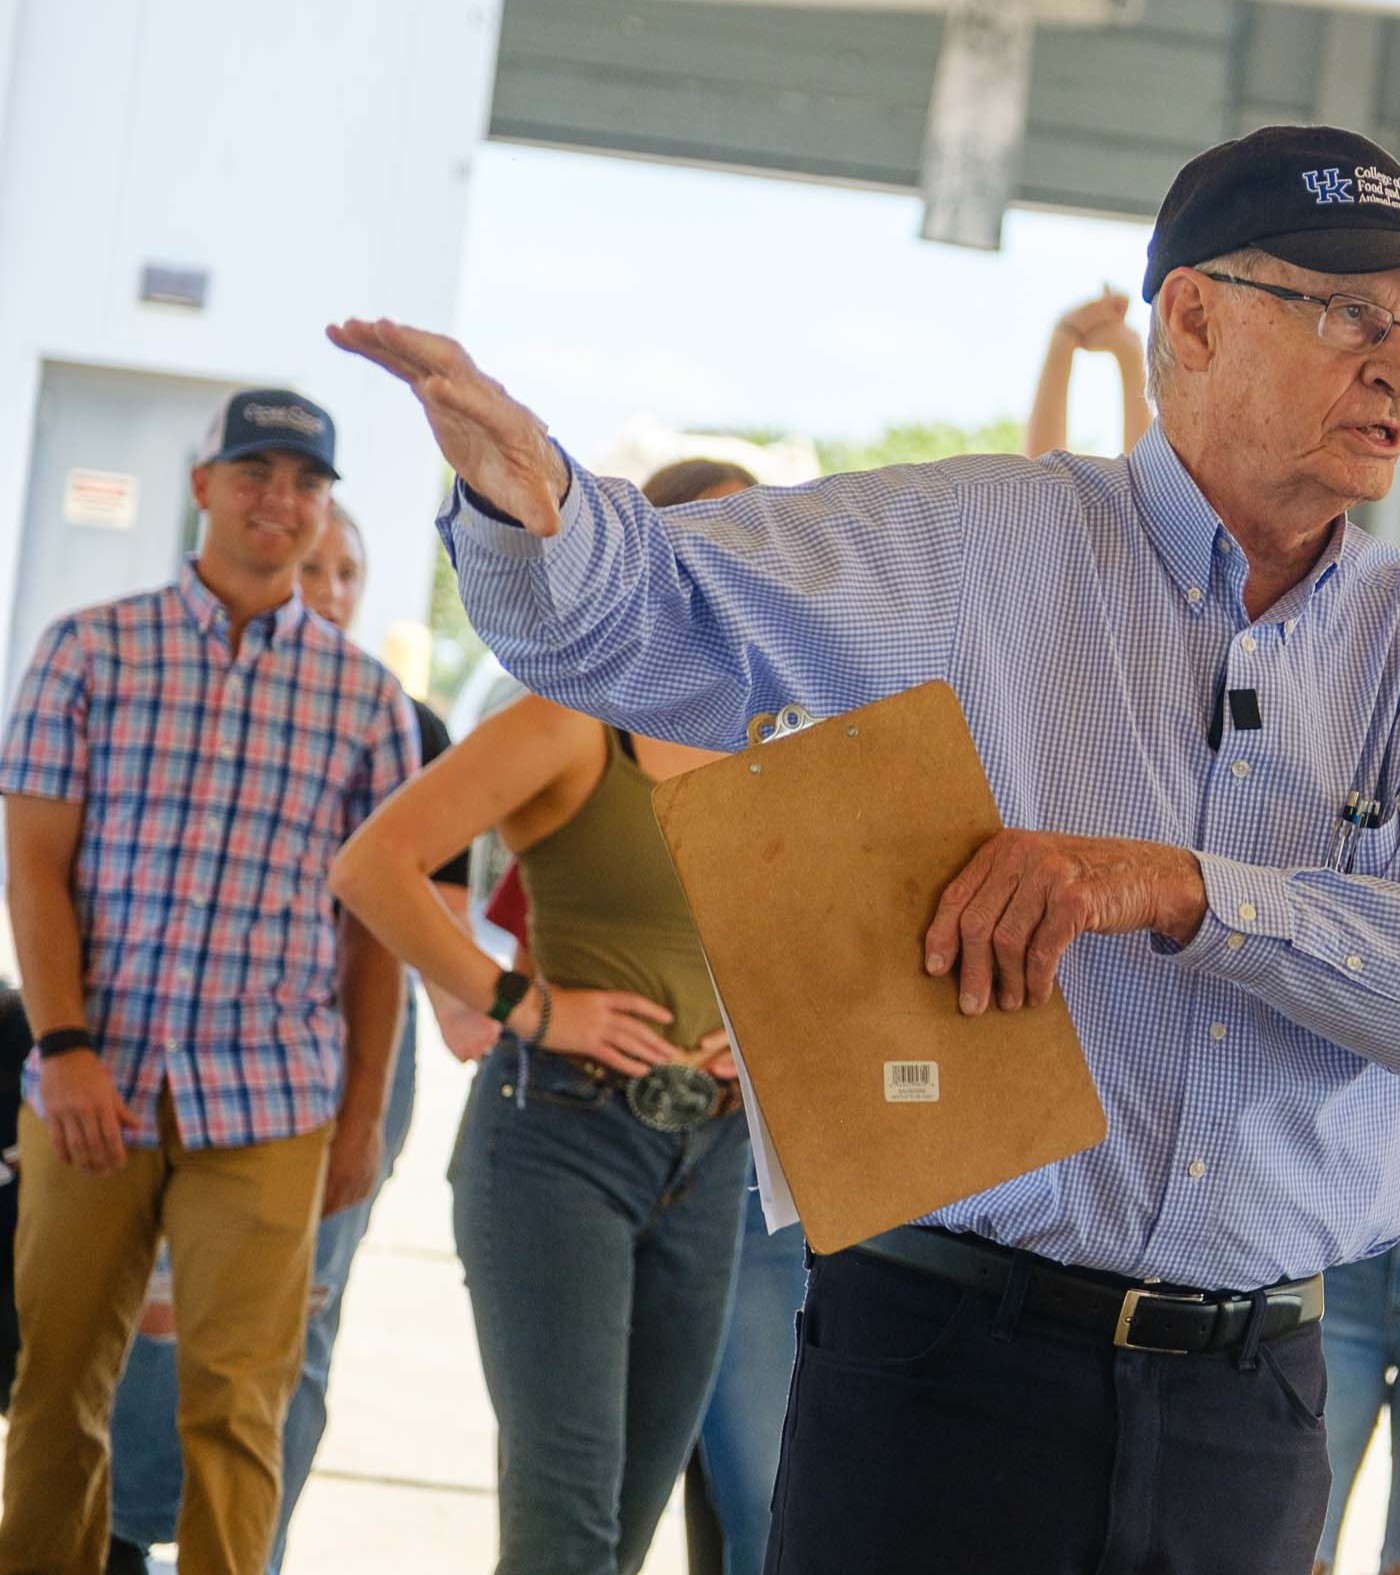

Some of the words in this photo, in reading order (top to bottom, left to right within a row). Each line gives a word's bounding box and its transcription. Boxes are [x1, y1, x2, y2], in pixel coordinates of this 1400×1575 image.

[1302, 168, 1355, 204] UK
[1354, 166, 1392, 186] College
[1358, 179, 1384, 196] Food
[1385, 187, 1400, 200] and
[1359, 192, 1391, 207] Animal
